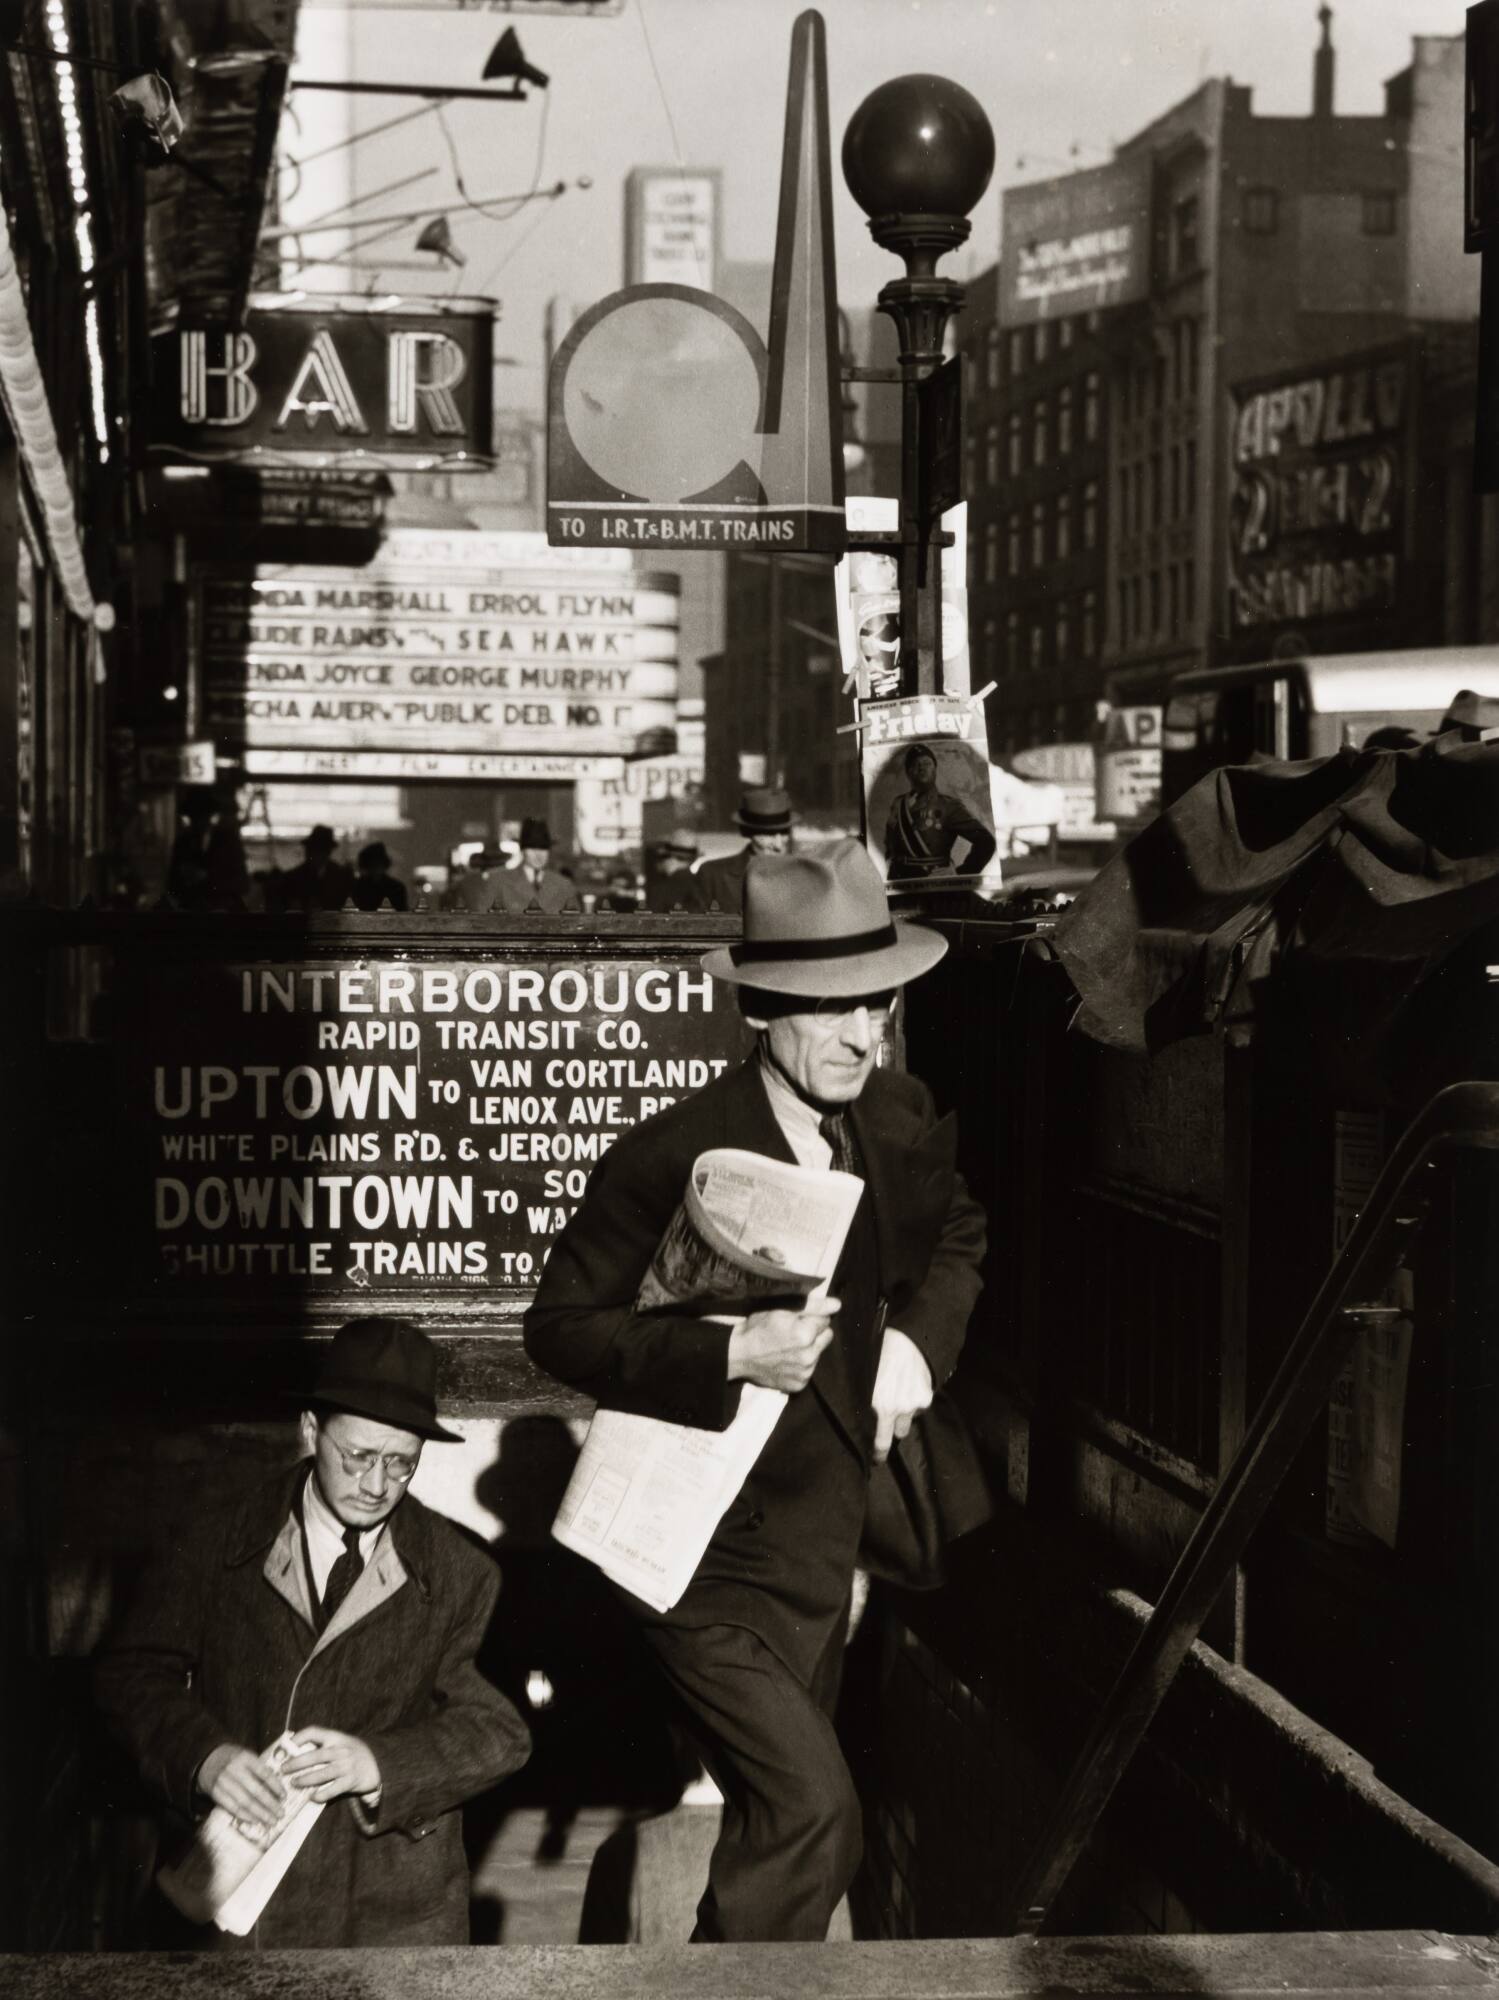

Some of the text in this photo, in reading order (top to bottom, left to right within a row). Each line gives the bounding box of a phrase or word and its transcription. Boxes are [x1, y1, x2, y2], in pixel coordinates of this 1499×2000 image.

[180, 331, 467, 435] BAR
[1238, 364, 1404, 462] APOLLO
[559, 518, 585, 538] TO
[720, 519, 795, 541] TRAINS
[317, 590, 451, 612] MARSHALL
[469, 593, 546, 616] ERROL
[558, 594, 635, 617] FLYNN
[458, 629, 514, 651] SEA
[315, 664, 393, 684] JOYCE
[410, 665, 509, 688] GEORGE
[521, 667, 632, 690] MURPHY
[867, 705, 973, 740] Friday
[242, 969, 714, 1013] INTERBOROUGH
[319, 1020, 649, 1050] RAPID TRANSIT CO.
[470, 1059, 728, 1088] VAN CORTLANDT
[154, 1065, 461, 1120] UPTOWN TO
[469, 1096, 558, 1125] LENOX
[161, 1134, 254, 1162] WHITE
[271, 1133, 381, 1162] PLAINS
[458, 1136, 480, 1162] &
[489, 1132, 618, 1162] JEROME
[544, 1169, 592, 1199] SO
[155, 1175, 518, 1230] DOWNTOWN TO
[162, 1243, 333, 1276] SHUTTLE
[350, 1242, 489, 1275] TRAINS
[500, 1251, 533, 1274] TO
